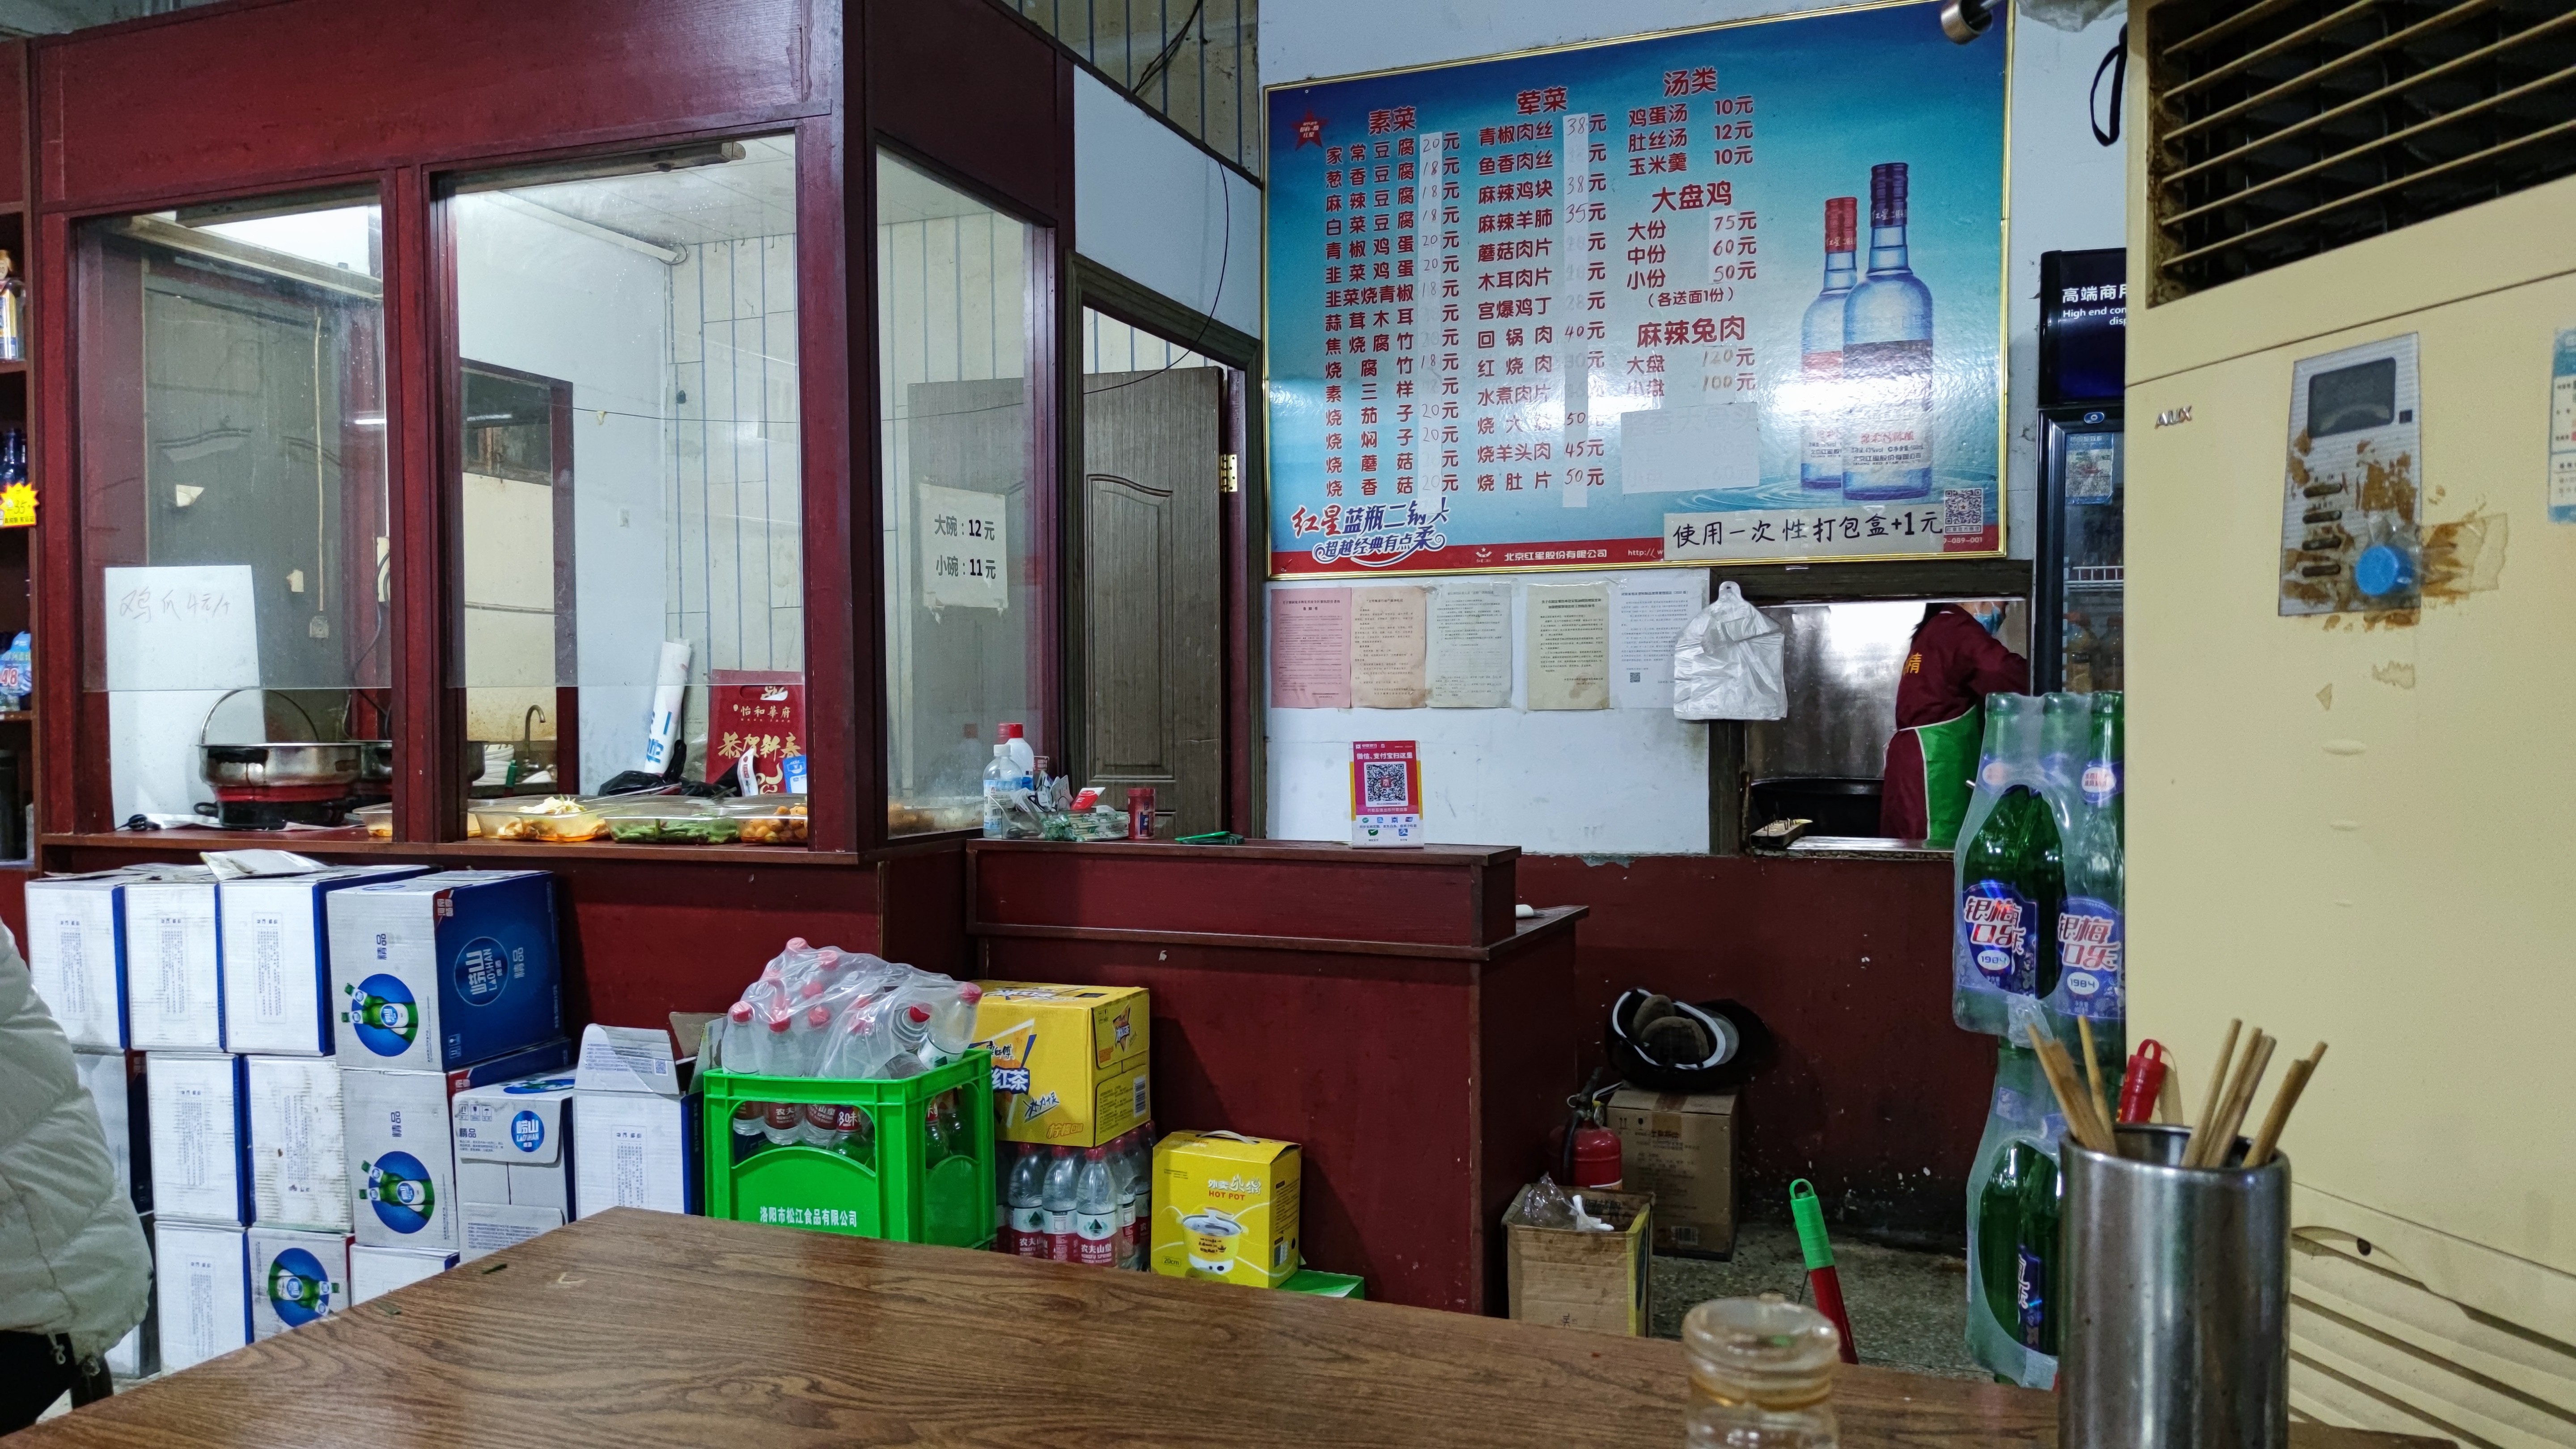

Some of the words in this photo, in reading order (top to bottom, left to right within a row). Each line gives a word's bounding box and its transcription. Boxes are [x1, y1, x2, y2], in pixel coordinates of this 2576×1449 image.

[1663, 66, 1717, 98] 汤类
[1517, 86, 1568, 115] 荤菜
[1628, 103, 1688, 129] 鸡蛋汤
[1714, 95, 1754, 116] 10元
[1368, 106, 1416, 136] 素菜
[1478, 121, 1552, 146] 青椒肉丝
[1568, 114, 1607, 134] 38元
[1325, 136, 1415, 166] 家常豆腐
[1424, 133, 1461, 153] 20元
[1627, 128, 1688, 153] 肚丝汤
[1714, 120, 1754, 140] 12元
[1325, 161, 1415, 190] 葱香豆腐
[1423, 158, 1460, 176] 18元
[1478, 151, 1552, 175] 鱼香肉丝
[1628, 152, 1687, 177] 玉米羹
[1714, 145, 1754, 166] 10元
[1325, 185, 1415, 213] 麻辣豆腐
[1423, 183, 1460, 199] 18元
[1478, 180, 1552, 203] 麻辣鸡块
[1567, 174, 1606, 194] 38元
[1652, 180, 1732, 213] 大盘鸡
[1325, 209, 1415, 237] 白菜豆腐
[1423, 208, 1460, 224] 18元
[1478, 209, 1552, 233] 麻辣羊肺
[1566, 203, 1606, 223] 35元
[1627, 220, 1666, 243] 大份
[1713, 212, 1757, 232] 75元
[1325, 235, 1415, 261] 青椒鸡蛋
[1422, 232, 1460, 249] 20元
[1478, 239, 1552, 261] 蘑菇肉片
[1627, 245, 1665, 266] 中份
[1713, 236, 1757, 257] 60元
[1325, 260, 1415, 285] 韭菜鸡蛋
[1424, 256, 1460, 273] 20元
[1478, 268, 1552, 290] 木耳肉片
[1627, 269, 1665, 291] 小份
[1713, 261, 1757, 283] 50元
[1325, 285, 1415, 310] 韭菜烧青椒
[1422, 280, 1460, 297] 18元
[1478, 297, 1552, 319] 宫爆鸡丁
[1325, 308, 1415, 333] 蒜茸木耳
[2063, 308, 2086, 319] High
[2089, 306, 2107, 316] end
[1325, 333, 1415, 356] 焦烧腐竹
[1478, 326, 1552, 349] 回锅肉
[1564, 322, 1605, 339] 40元
[1637, 315, 1746, 349] 麻辣兔肉
[1325, 357, 1415, 380] 烧腐竹
[1421, 354, 1459, 370] 18元
[1478, 355, 1552, 377] 红烧肉
[1627, 354, 1665, 374] 大盘
[1702, 347, 1755, 368] 120元
[1325, 381, 1415, 404] 素三样
[1478, 384, 1552, 406] 水煮肉片
[1627, 379, 1665, 398] 小盘
[1703, 372, 1756, 393] 100元
[1325, 405, 1415, 428] 烧茄子
[1421, 402, 1459, 419] 20元
[2155, 406, 2192, 429] AUX
[1422, 427, 1459, 444] 20元
[1325, 453, 1415, 475] 烧蘑菇
[1478, 441, 1552, 463] 烧羊头肉
[1564, 440, 1604, 457] 45元
[1325, 477, 1415, 499] 烧香菇
[1421, 475, 1459, 491] 20元
[1478, 471, 1552, 492] 烧肚片
[1567, 468, 1604, 486] 50元
[1324, 525, 1435, 558] 超越经典有点柔
[1504, 549, 1607, 562] 北京红星股份有限公司
[741, 705, 791, 719] 怡和華府
[717, 732, 801, 762] 恭贺新春
[1965, 896, 2022, 928] 银梅
[2058, 915, 2113, 945] 银梅
[377, 933, 387, 960] 精品
[465, 950, 487, 995] 崂山
[513, 947, 525, 979] 精品
[2070, 978, 2095, 989] 1984
[391, 1111, 402, 1138] 精品
[516, 1119, 539, 1134] 崂山
[1208, 1190, 1226, 1199] HOT
[1229, 1193, 1246, 1201] POT
[760, 1206, 856, 1228] 洛阳市松江食品有限公司
[1081, 1243, 1112, 1254] 农夫山泉
[1164, 1257, 1179, 1266] 20cm
